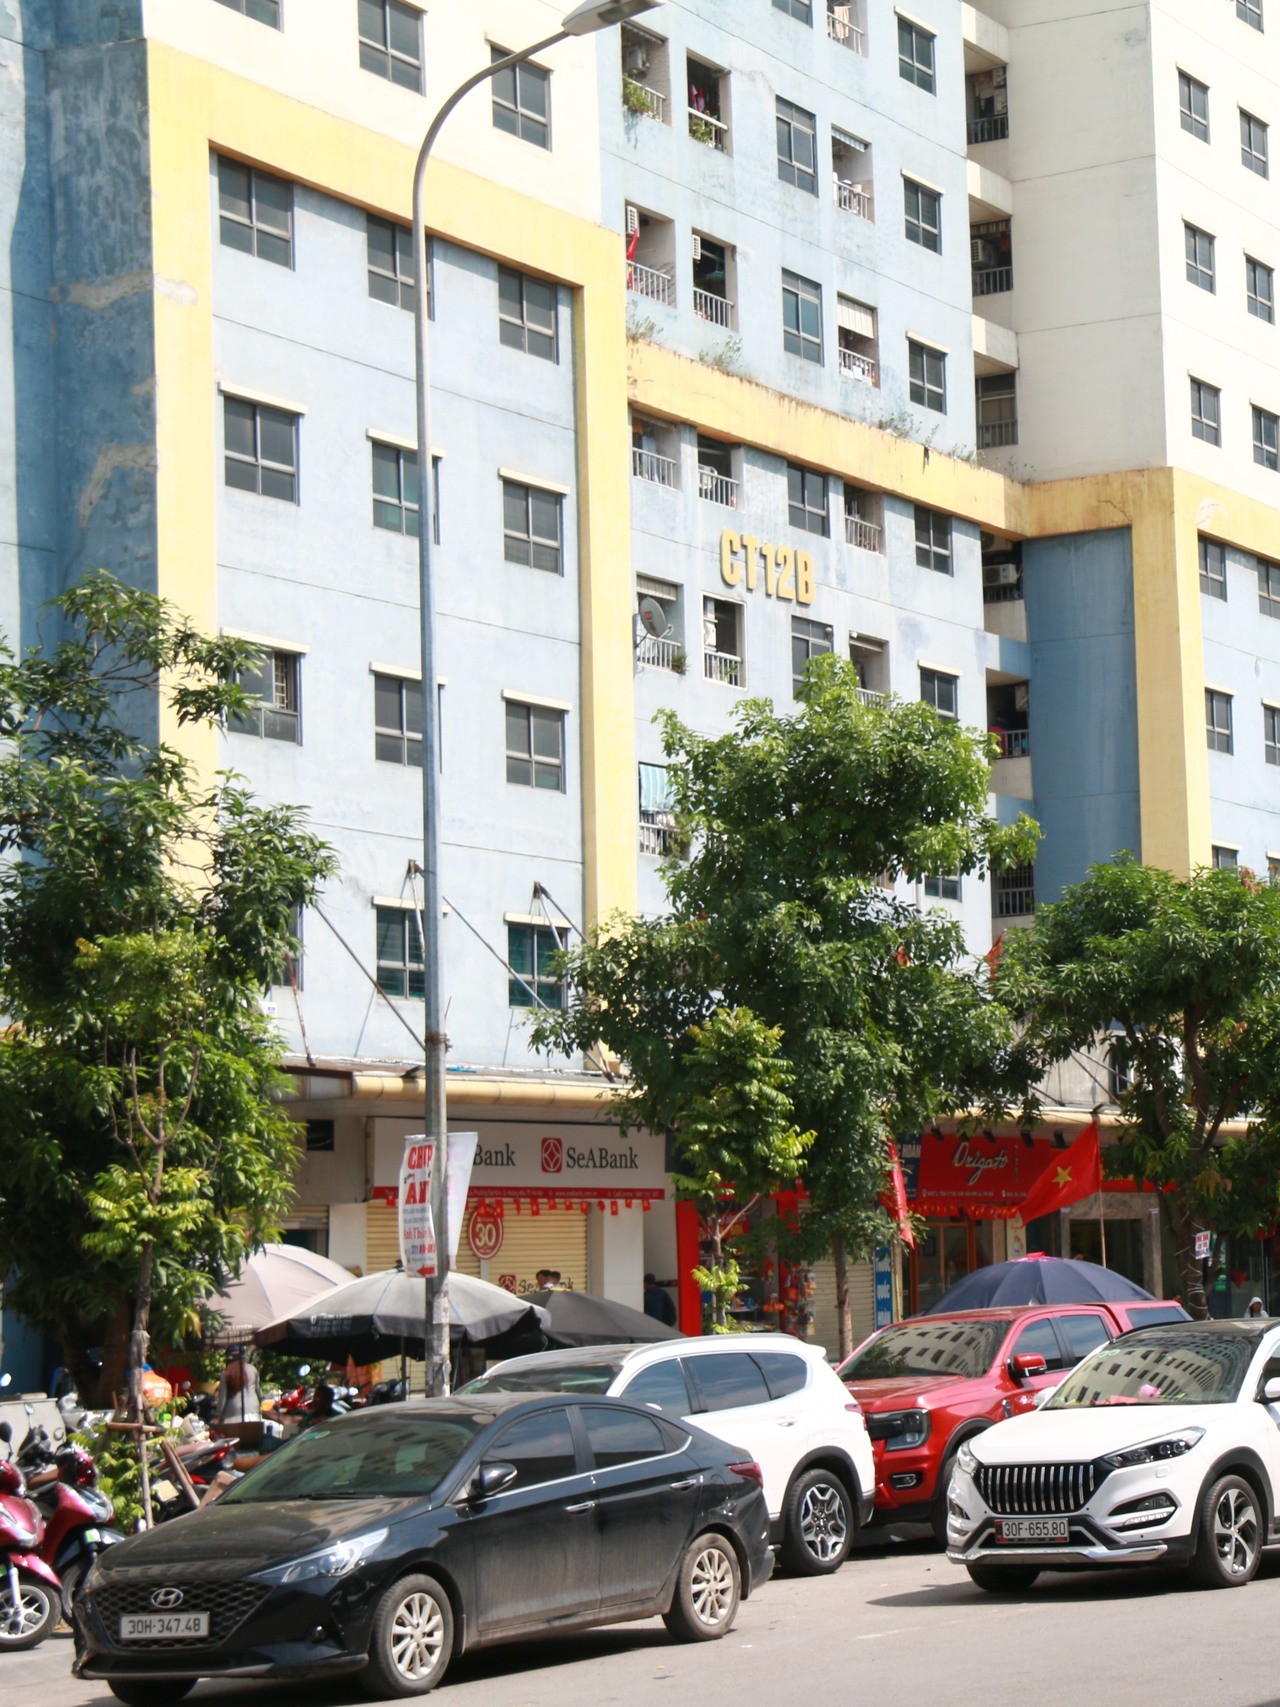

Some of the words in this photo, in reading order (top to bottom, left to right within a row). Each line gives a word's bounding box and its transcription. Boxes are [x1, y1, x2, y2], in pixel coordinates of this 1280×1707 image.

[720, 529, 816, 606] CT12B
[473, 1144, 516, 1167] Bank
[566, 1146, 639, 1169] SeABank
[475, 1223, 496, 1247] 30
[1004, 1521, 1066, 1537] 30F-655.80
[128, 1617, 201, 1635] 30H-347.48
